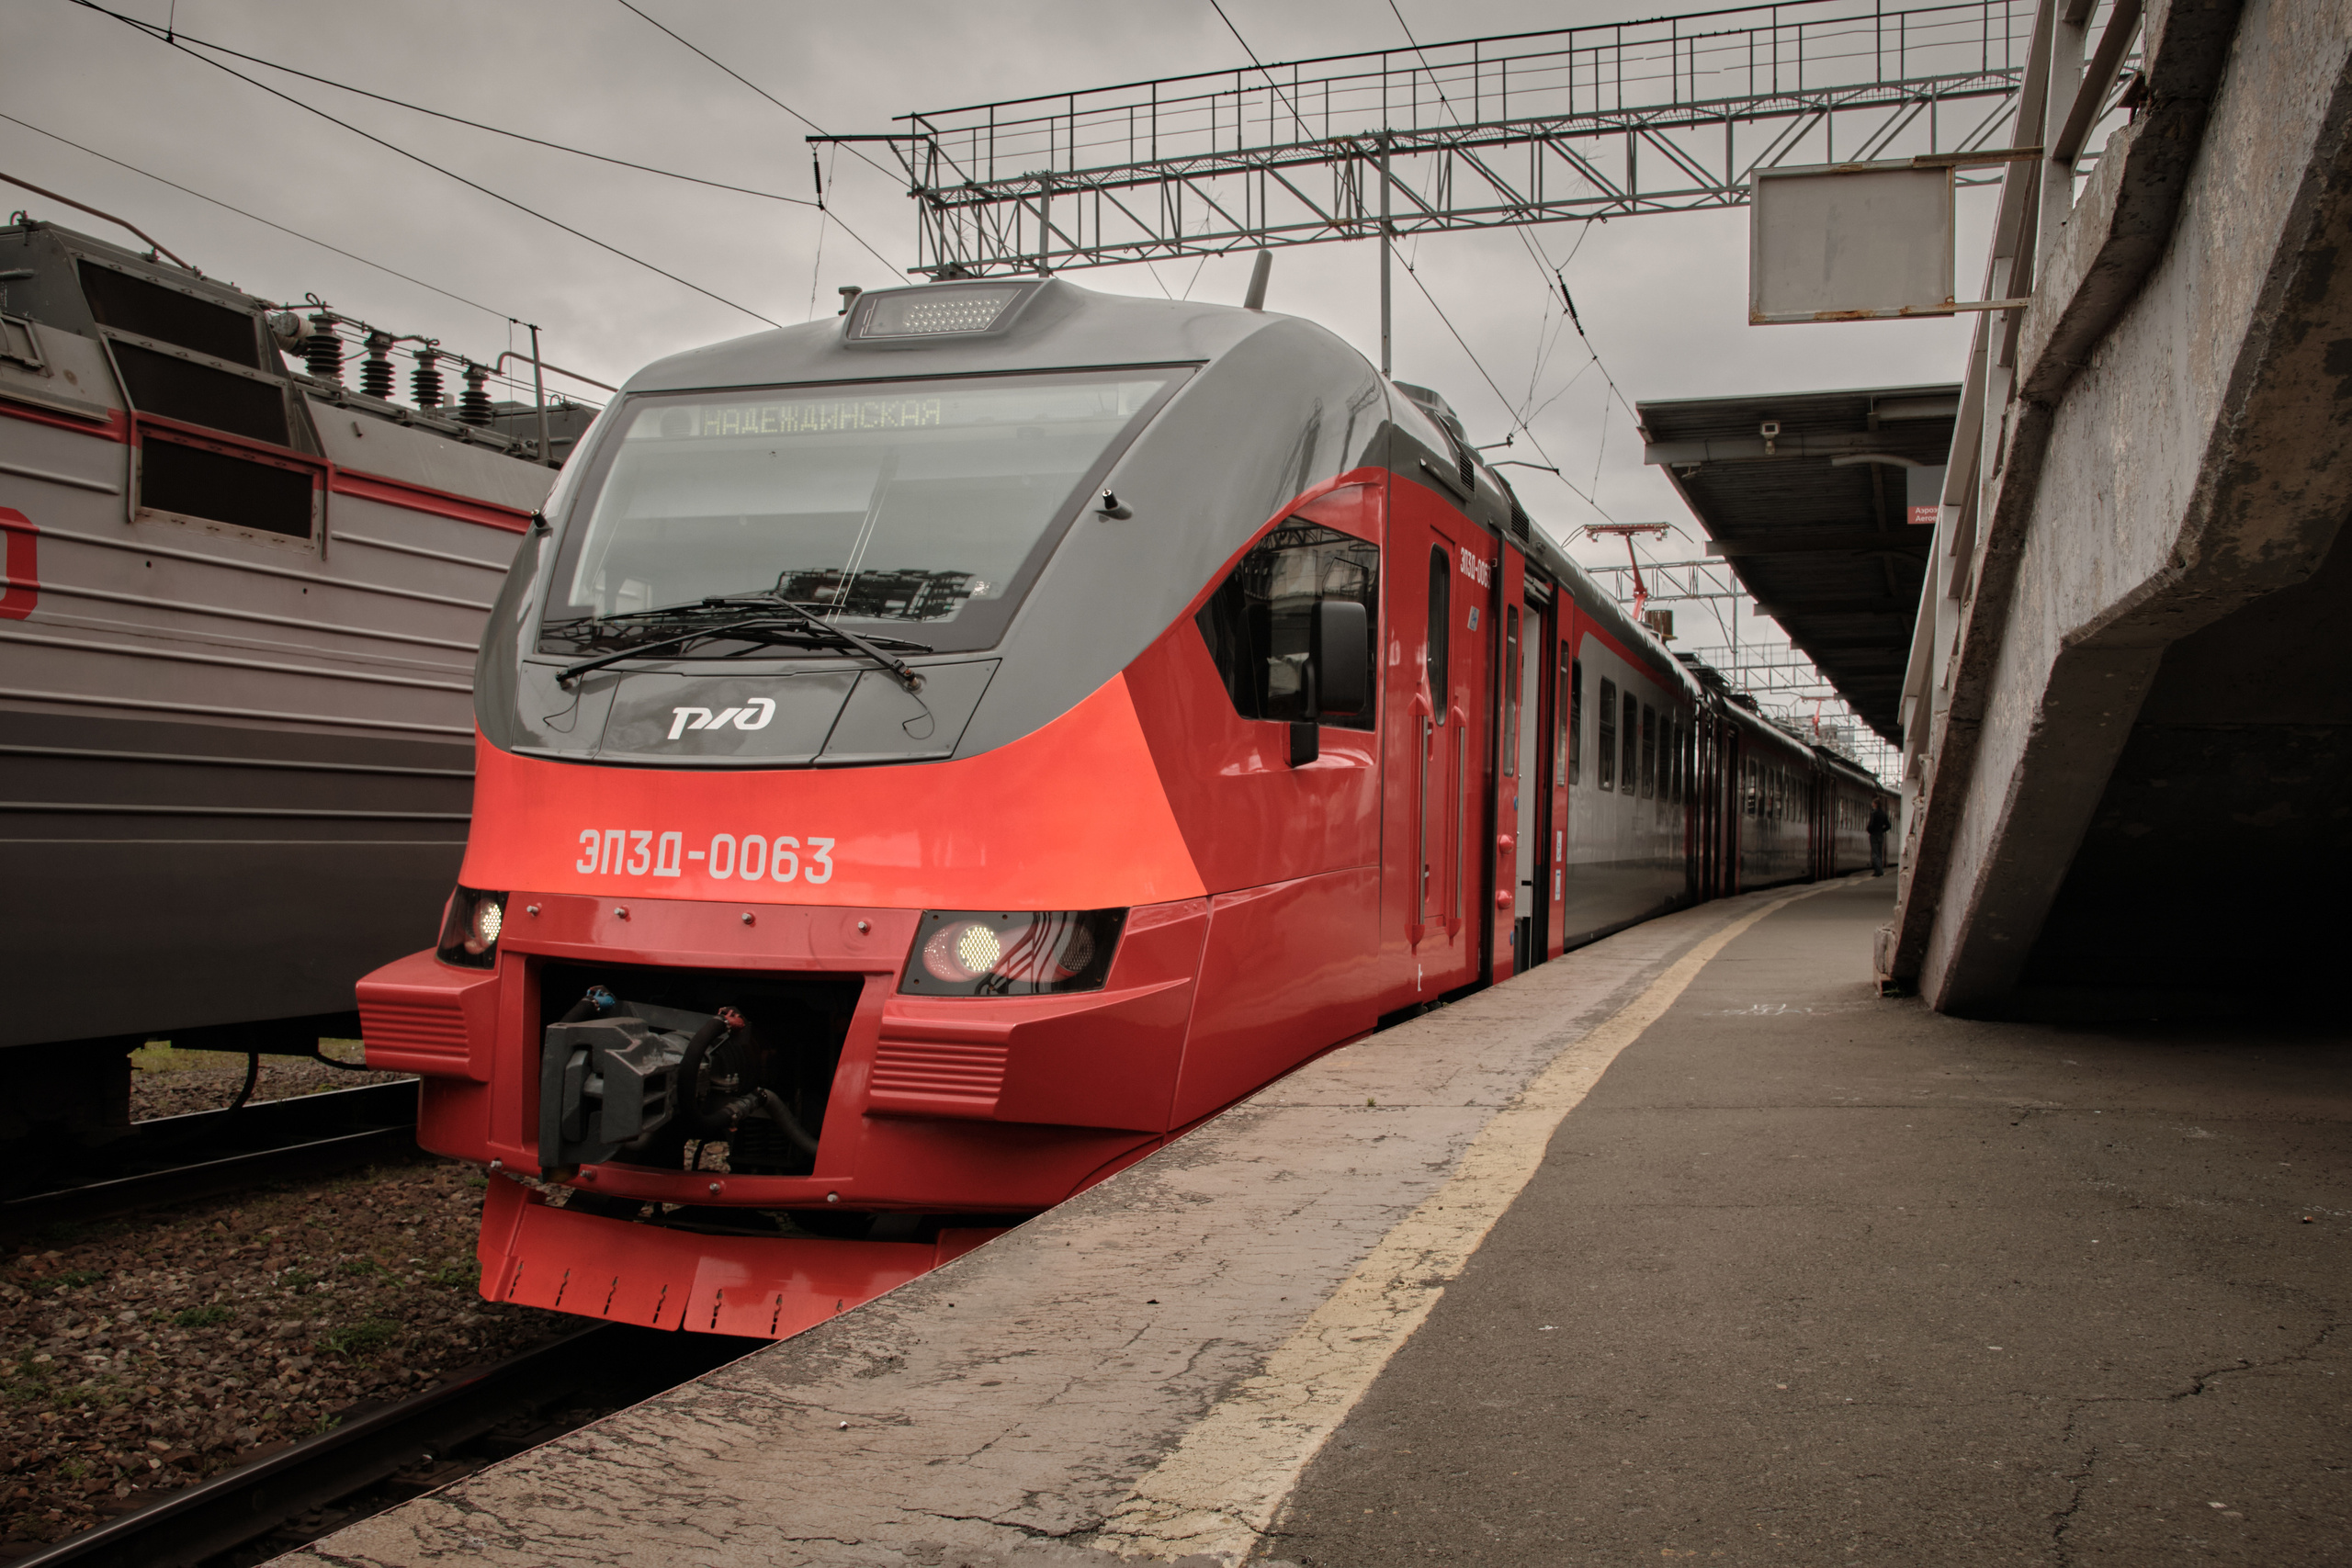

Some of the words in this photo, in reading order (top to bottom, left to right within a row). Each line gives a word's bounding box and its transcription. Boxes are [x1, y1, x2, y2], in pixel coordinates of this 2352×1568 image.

[704, 399, 941, 436] НАДЕЖДИНСКАЯ
[1915, 507, 1939, 515] Аэроэ
[576, 829, 835, 885] ЭП3Д-0063
